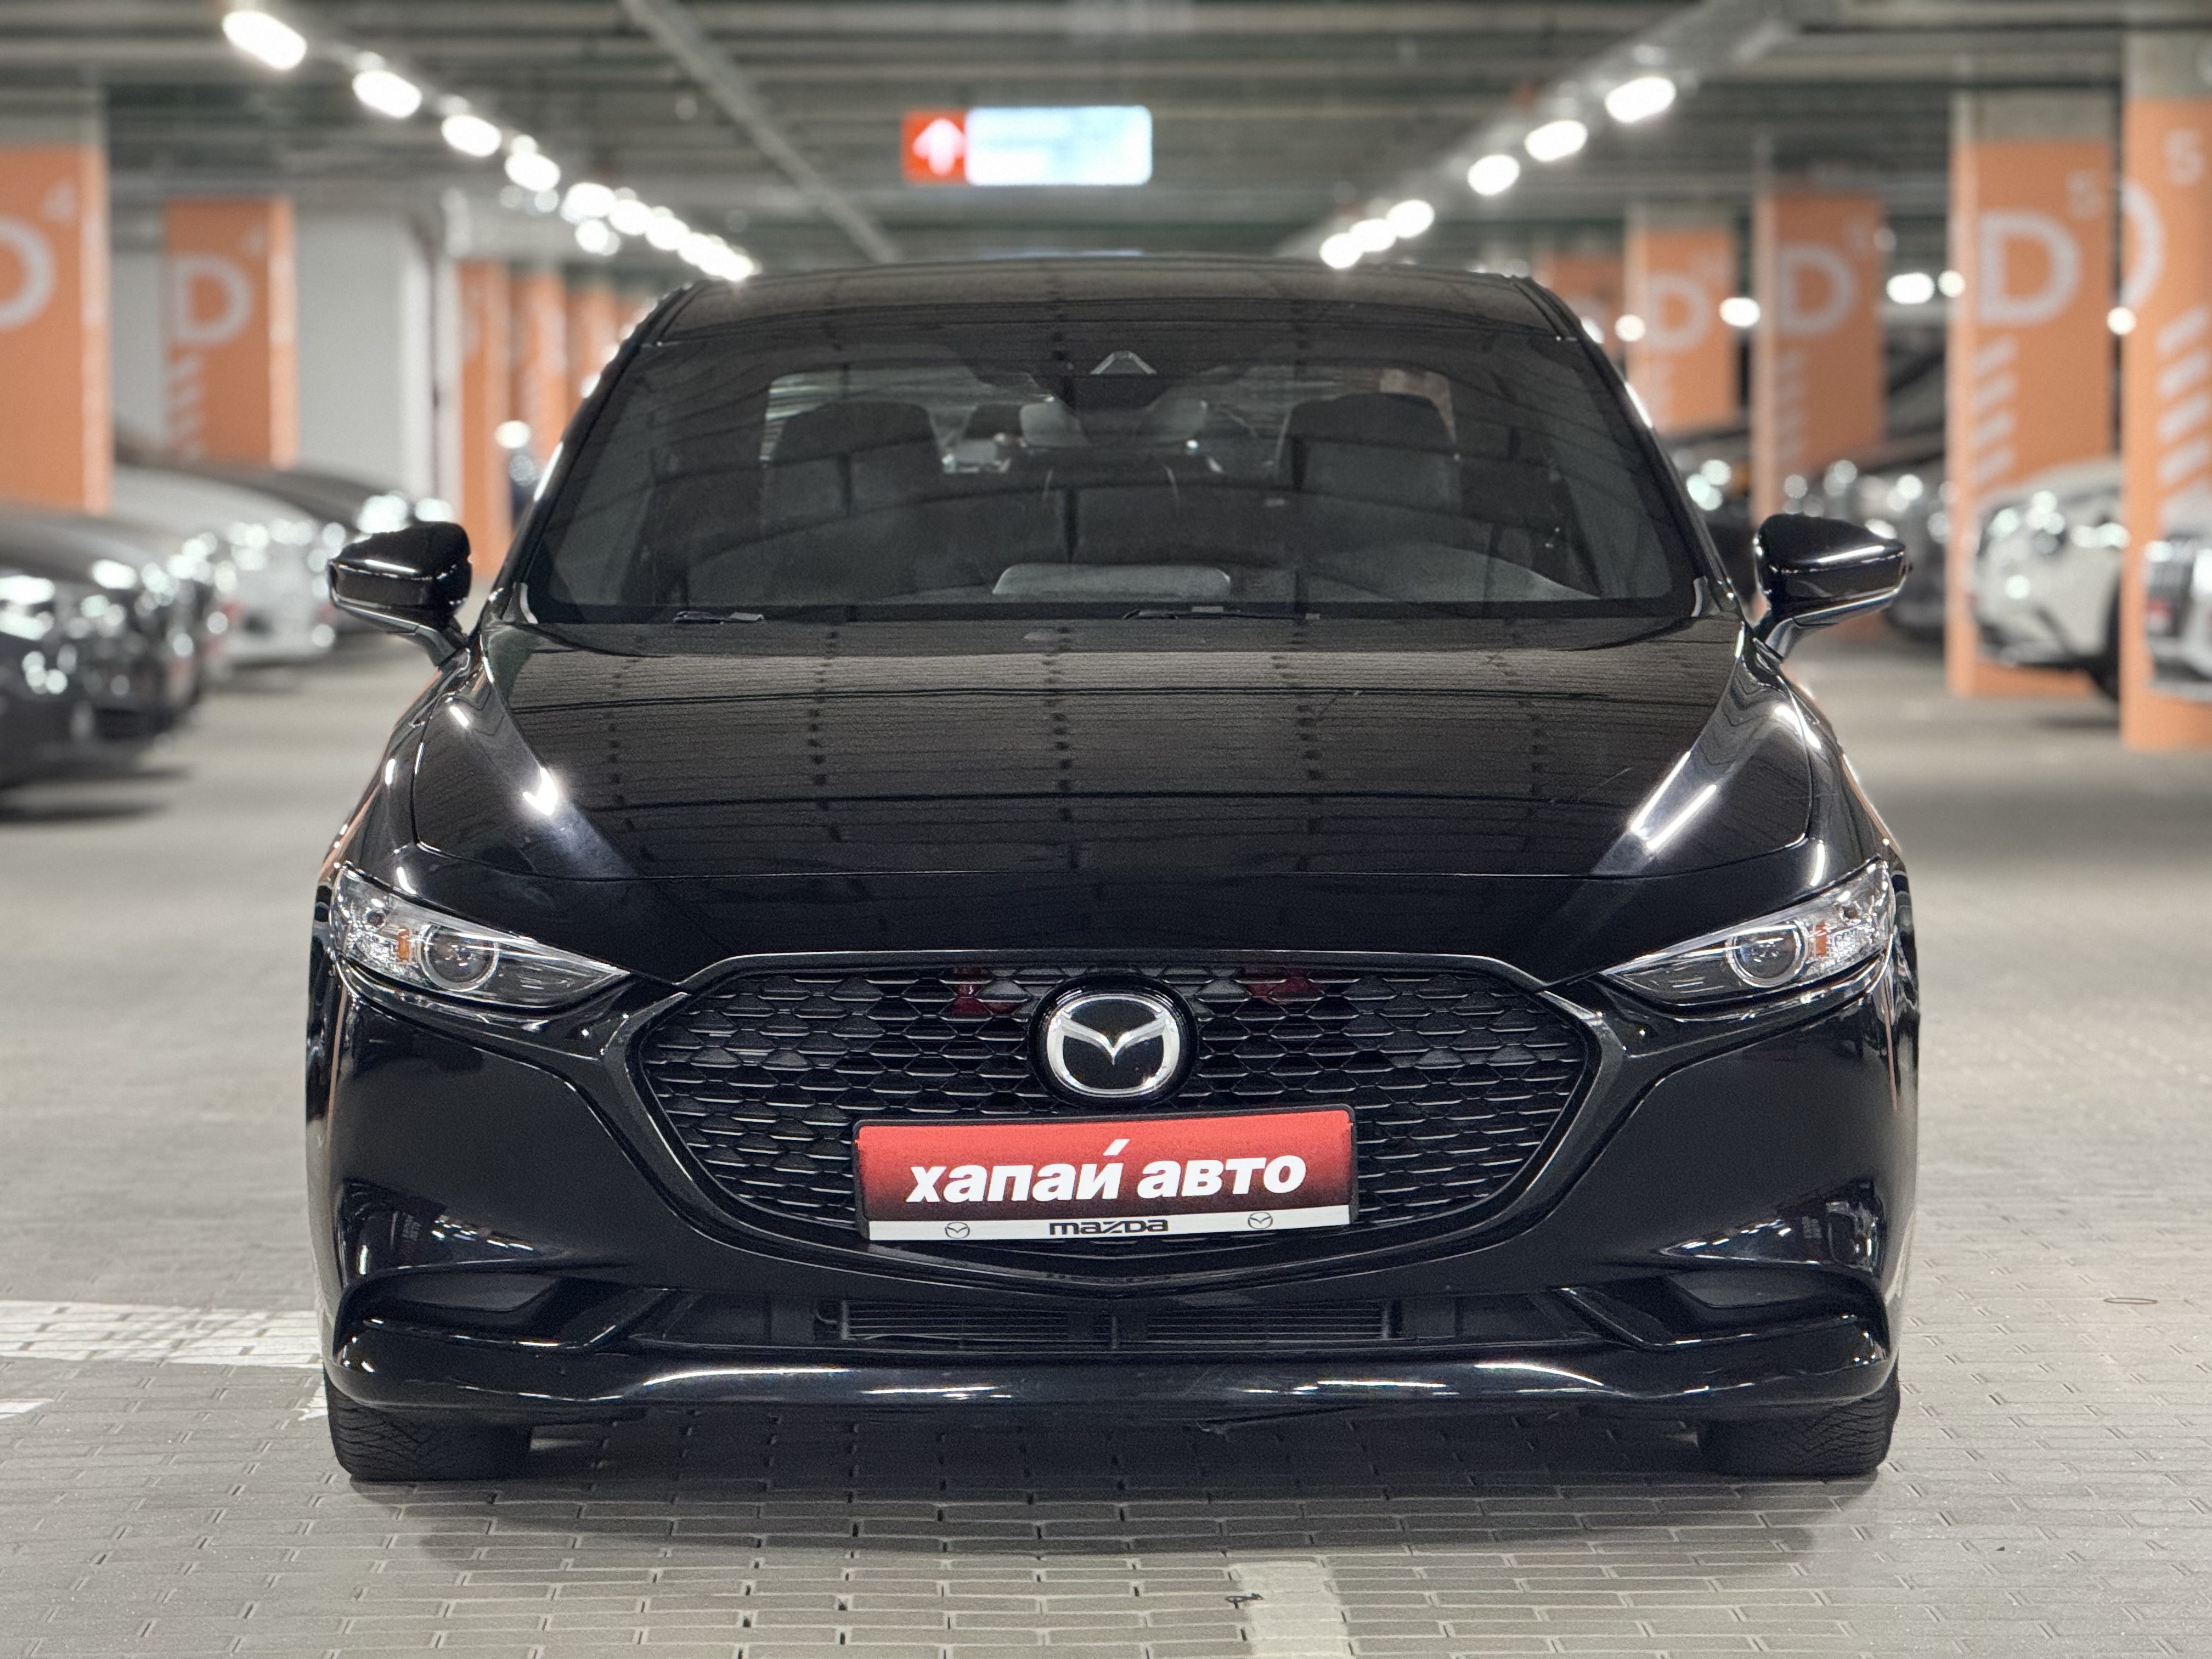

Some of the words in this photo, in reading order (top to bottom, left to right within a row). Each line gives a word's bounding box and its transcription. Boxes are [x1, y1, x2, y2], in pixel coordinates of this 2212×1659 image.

[173, 252, 253, 346] D
[1778, 243, 1857, 338] D
[1977, 209, 2082, 328] D
[1137, 1154, 1307, 1199] авто
